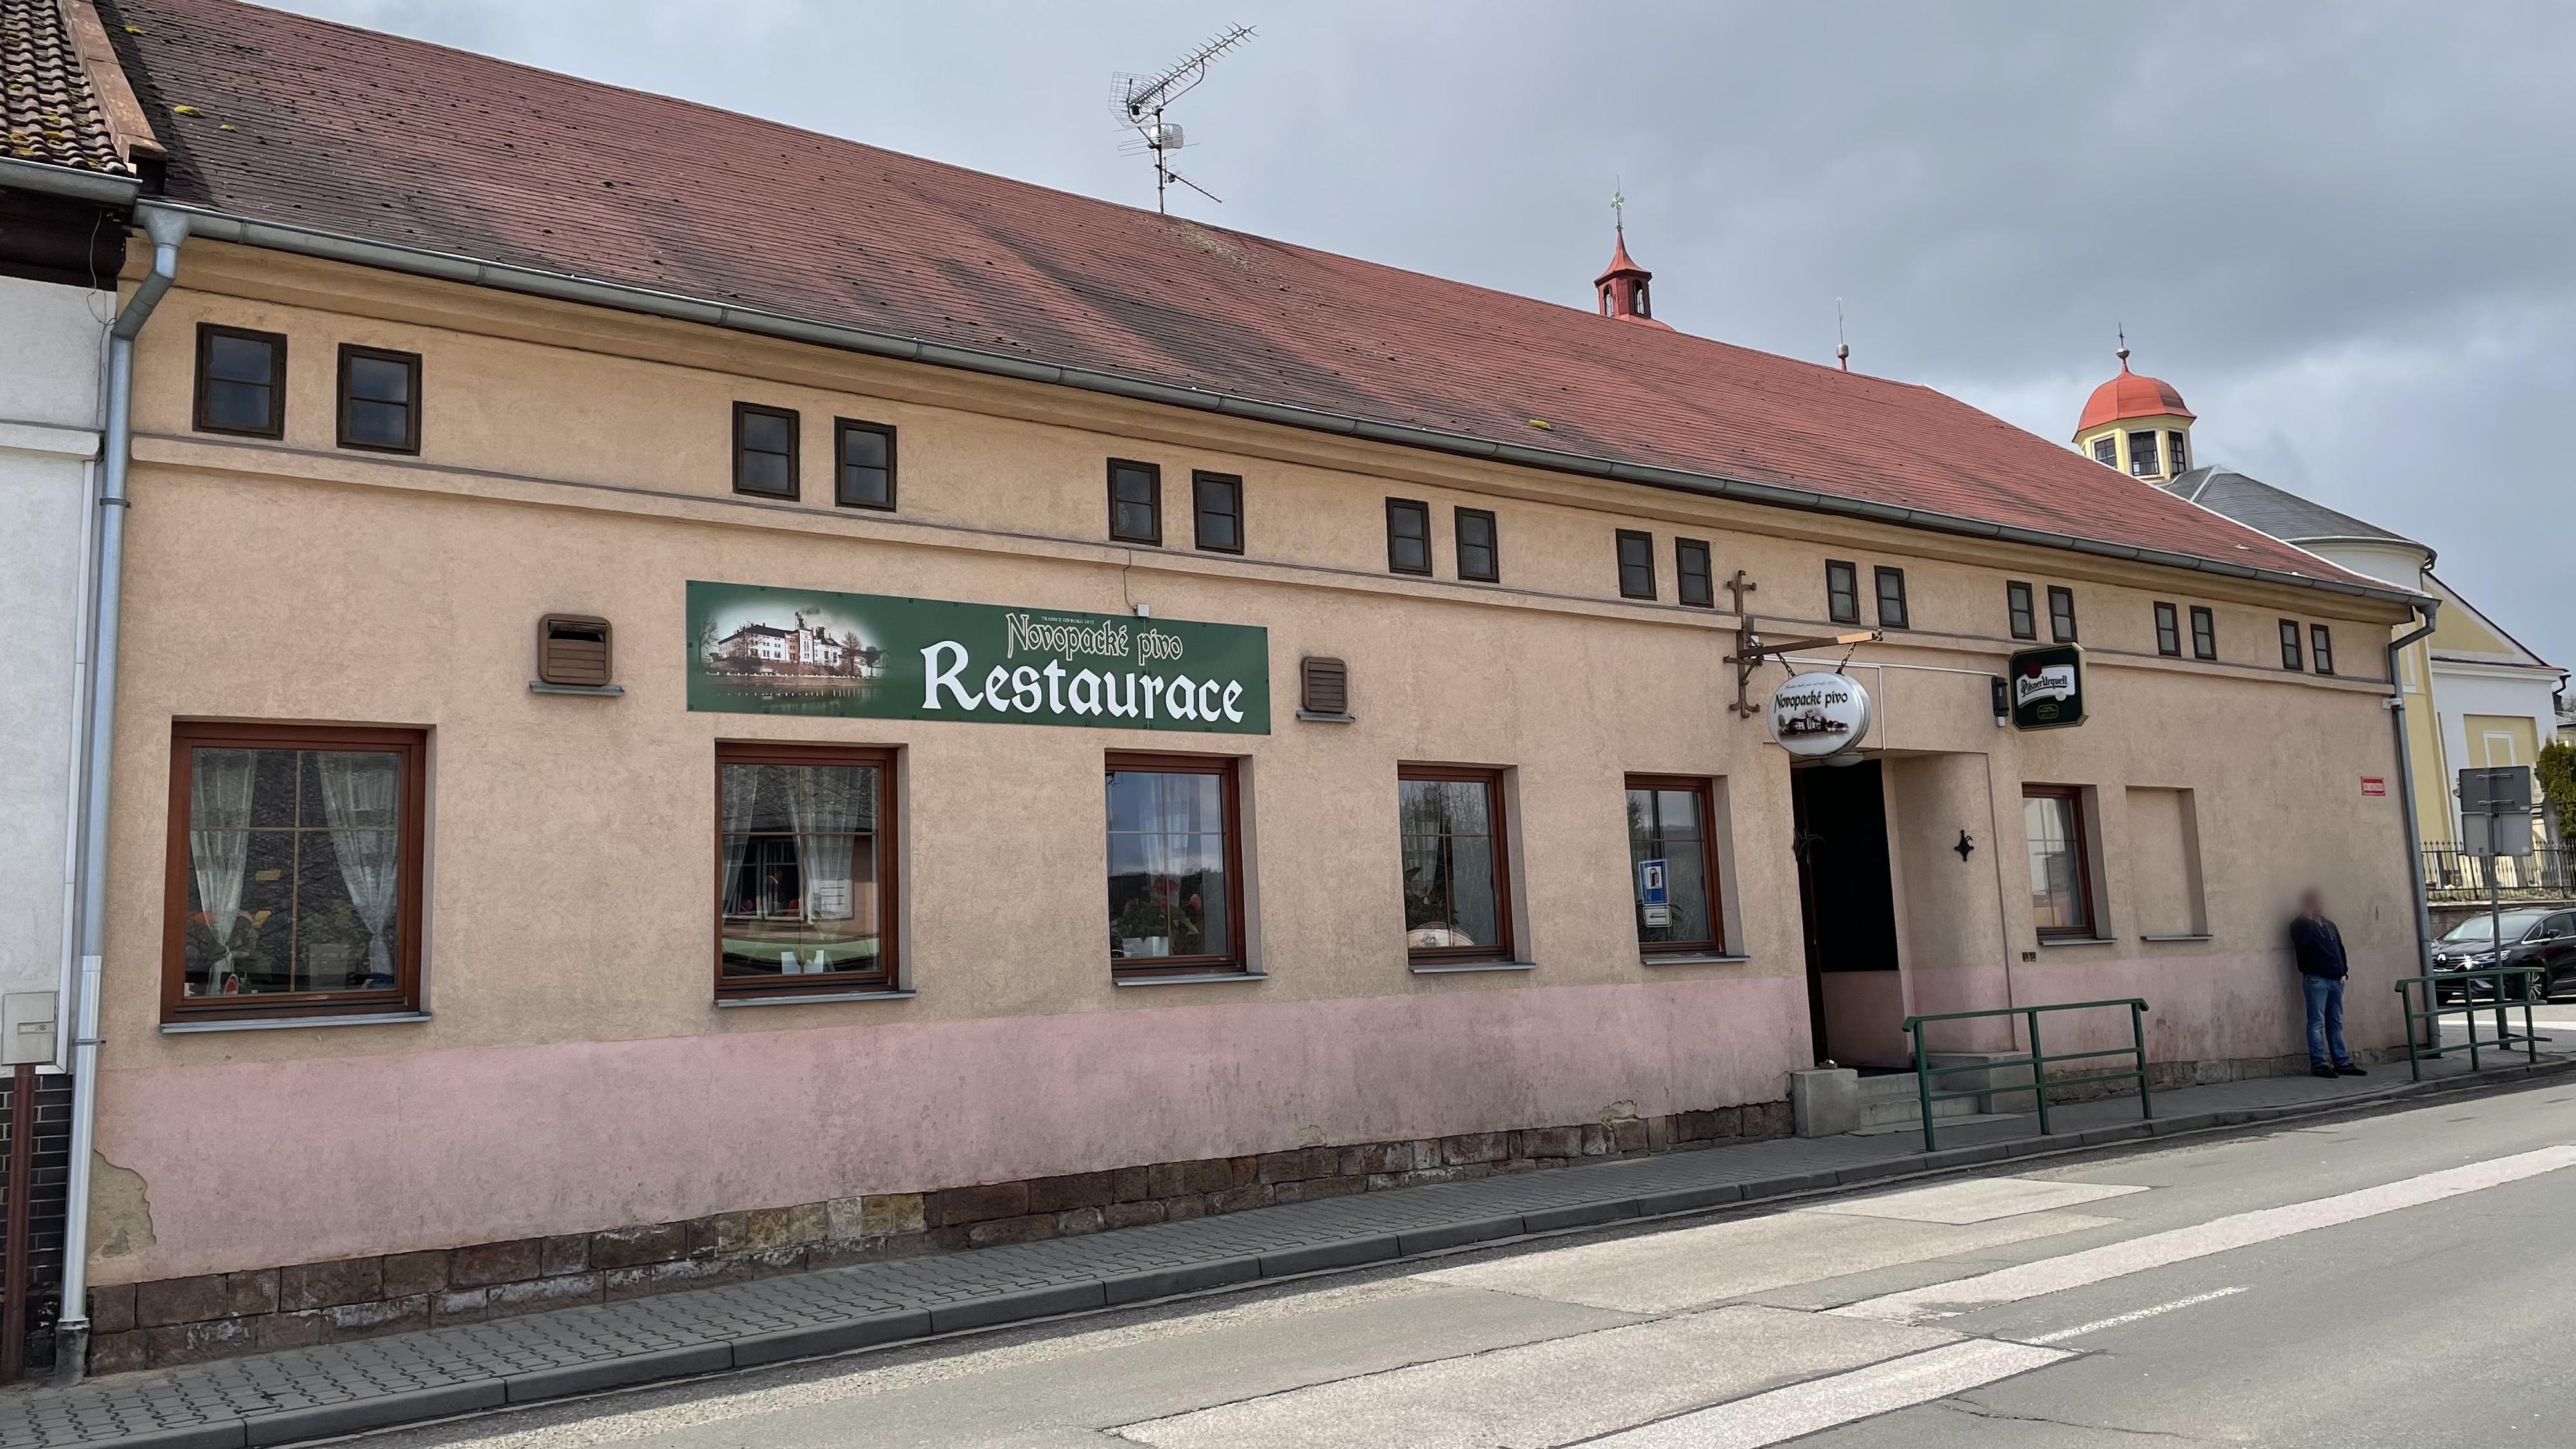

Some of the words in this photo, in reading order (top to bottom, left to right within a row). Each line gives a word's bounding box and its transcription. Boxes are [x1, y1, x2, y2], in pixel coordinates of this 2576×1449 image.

[1005, 613, 1129, 661] Novopacké
[1137, 629, 1183, 666] pivo
[920, 641, 1244, 723] Restaurace
[2021, 679, 2043, 697] Pilsner
[2041, 675, 2067, 689] Urquell
[1774, 690, 1821, 714] Novopacké
[1825, 691, 1848, 708] pivo
